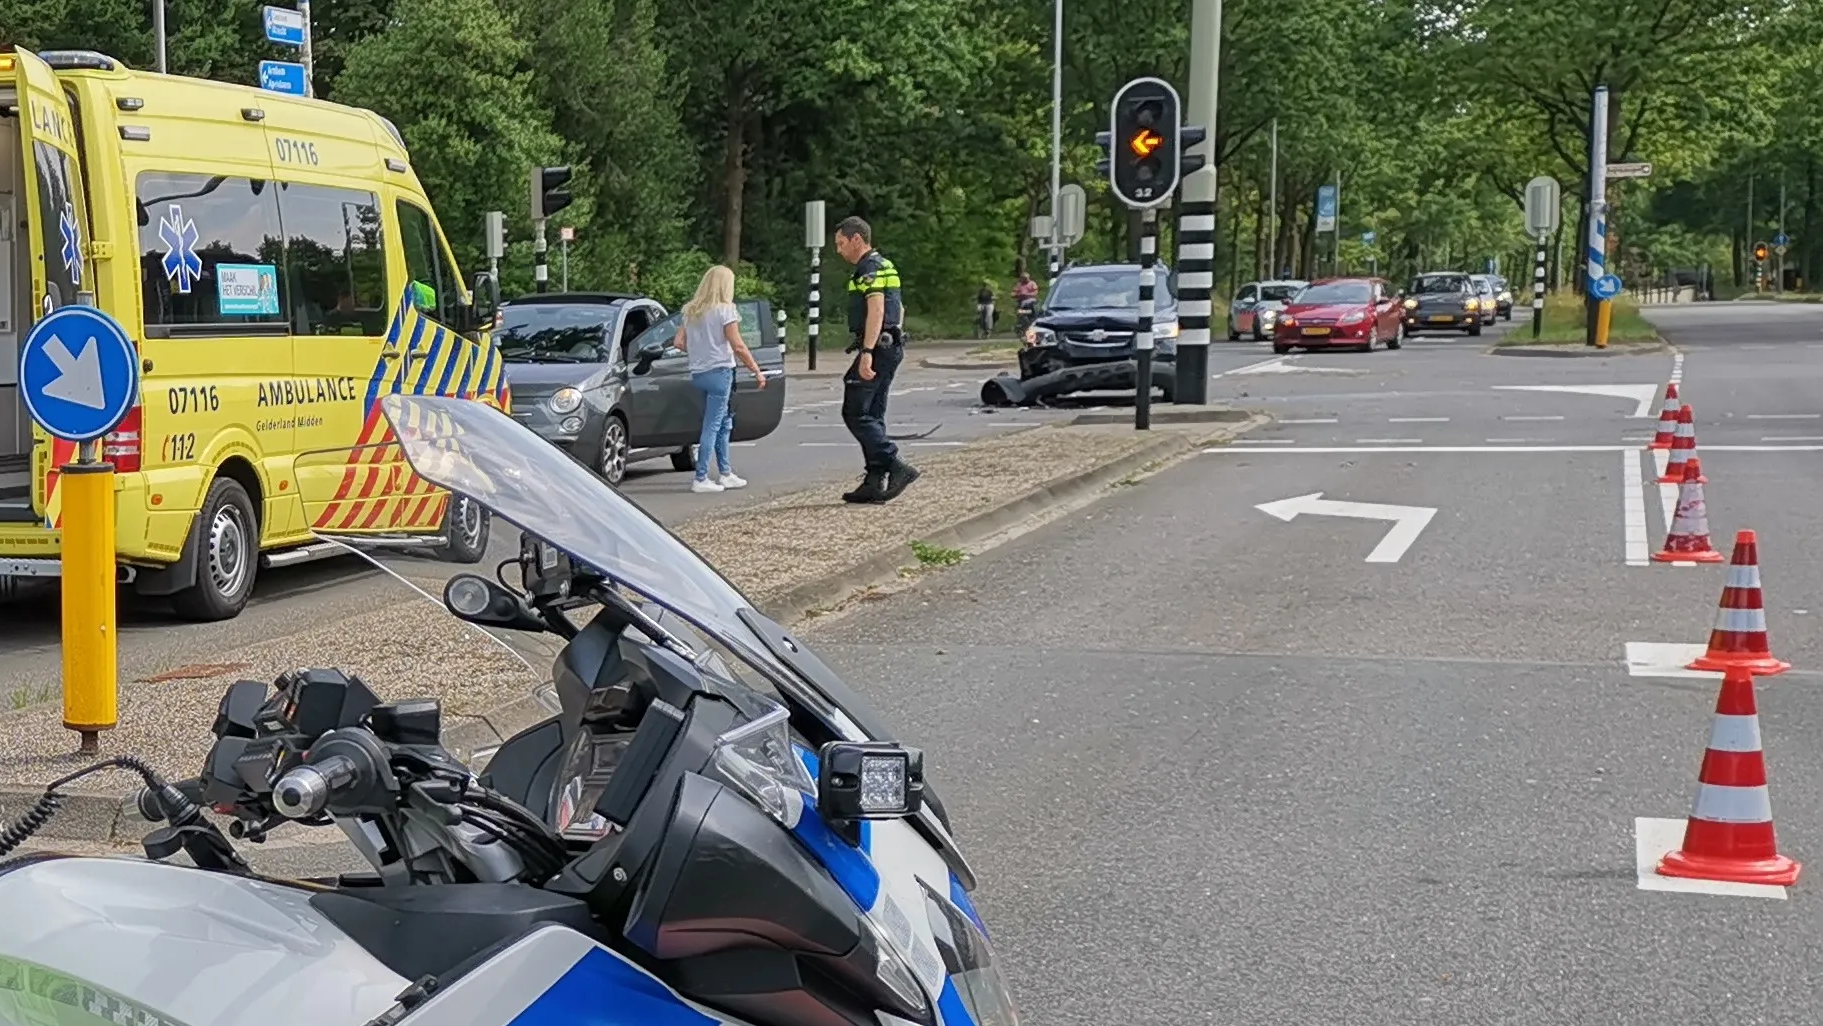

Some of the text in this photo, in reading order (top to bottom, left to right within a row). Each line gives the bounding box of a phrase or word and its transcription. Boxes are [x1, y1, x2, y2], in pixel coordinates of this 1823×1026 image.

[275, 137, 318, 166] 07116
[168, 385, 219, 414] 07116
[257, 377, 356, 407] AMBULANCE
[256, 416, 323, 431] Gelderland Midden
